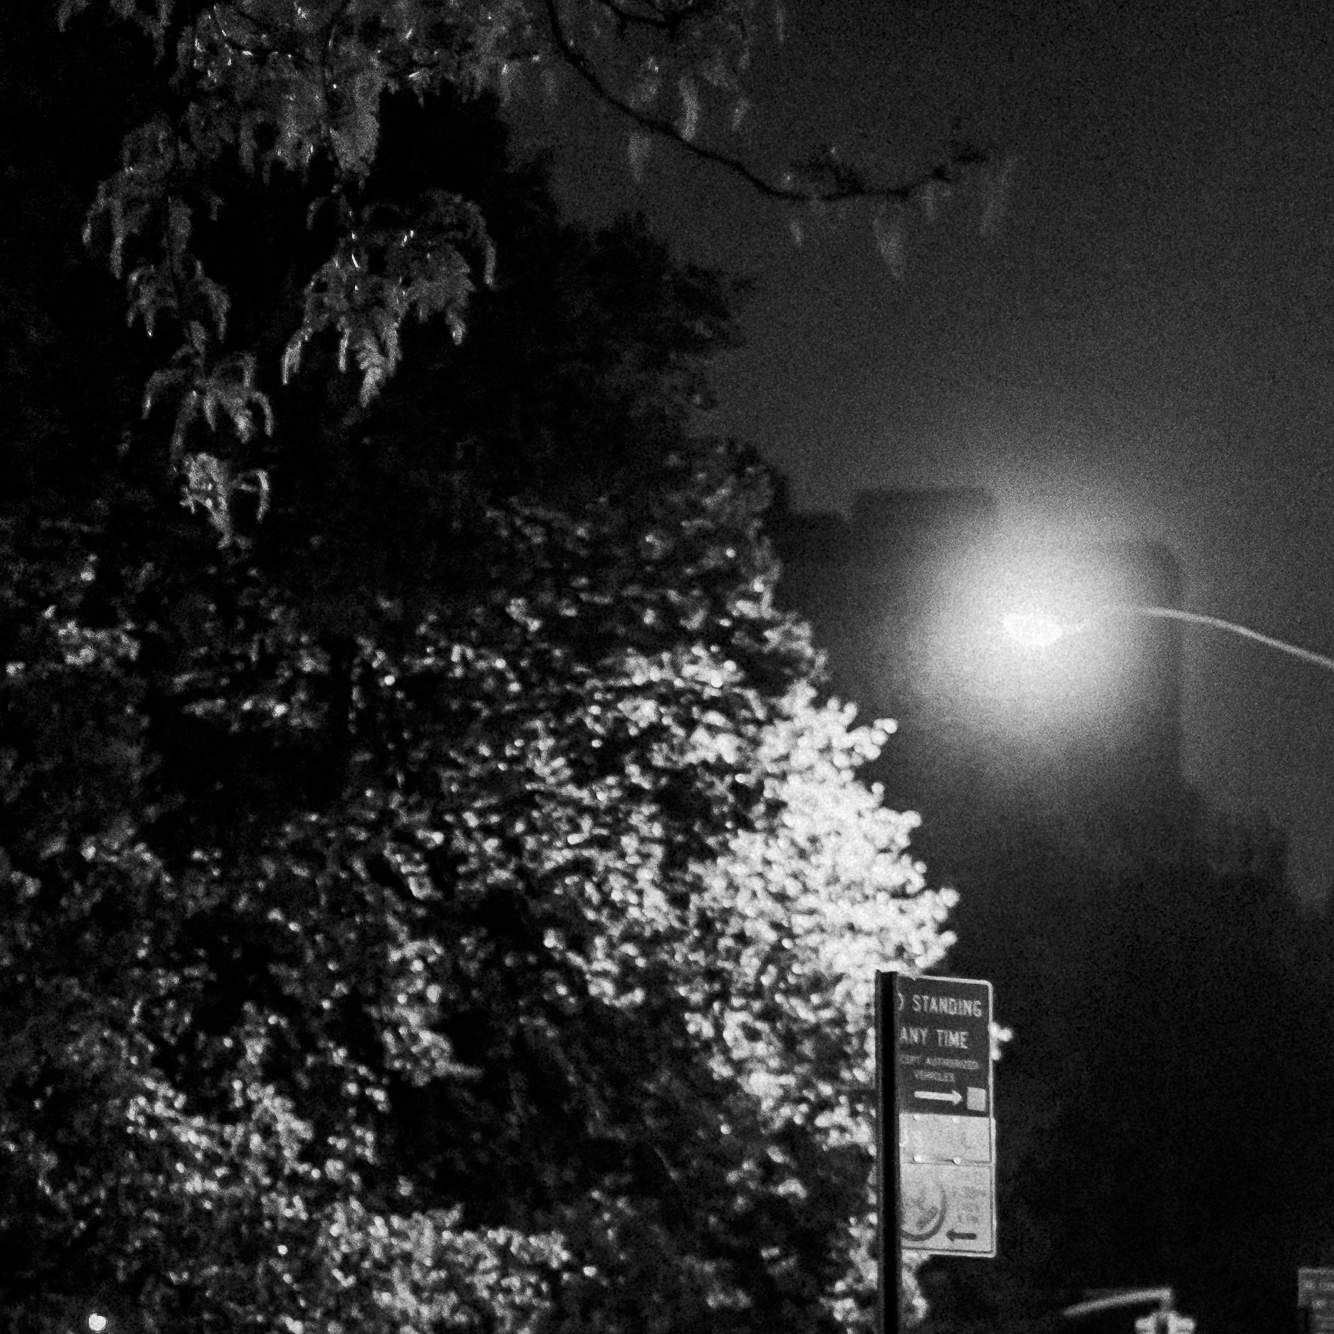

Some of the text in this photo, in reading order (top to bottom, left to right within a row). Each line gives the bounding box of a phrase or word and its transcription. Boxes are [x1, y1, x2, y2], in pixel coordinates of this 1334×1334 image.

[912, 994, 982, 1017] STANDING
[899, 1026, 969, 1049] ANY TIME
